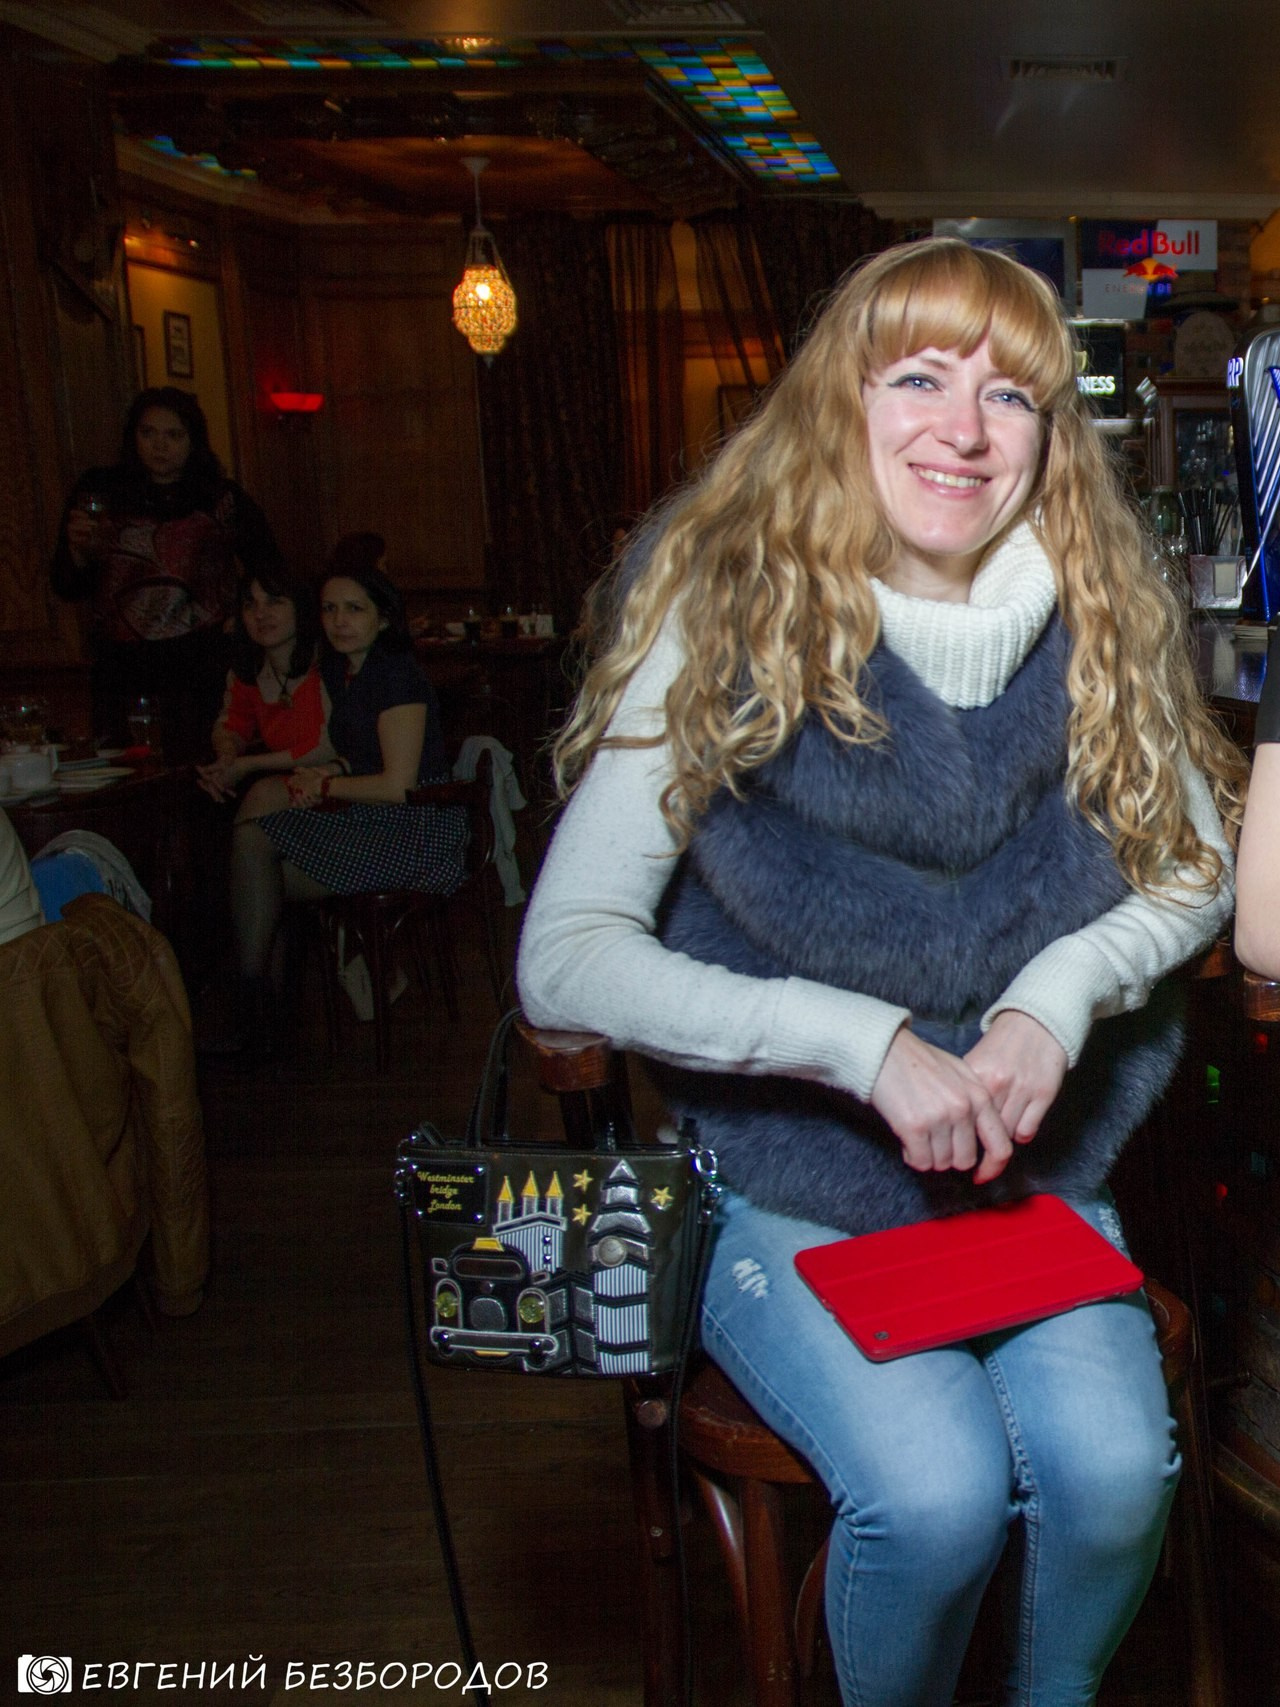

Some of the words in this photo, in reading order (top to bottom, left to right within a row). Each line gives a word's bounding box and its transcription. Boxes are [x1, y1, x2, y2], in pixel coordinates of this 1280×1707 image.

[1098, 229, 1148, 256] Red
[1153, 230, 1199, 256] Bull
[1227, 357, 1243, 387] RP
[1077, 376, 1116, 394] NESS
[416, 1171, 475, 1184] Westminster
[429, 1184, 459, 1199] bridge
[427, 1199, 463, 1214] London
